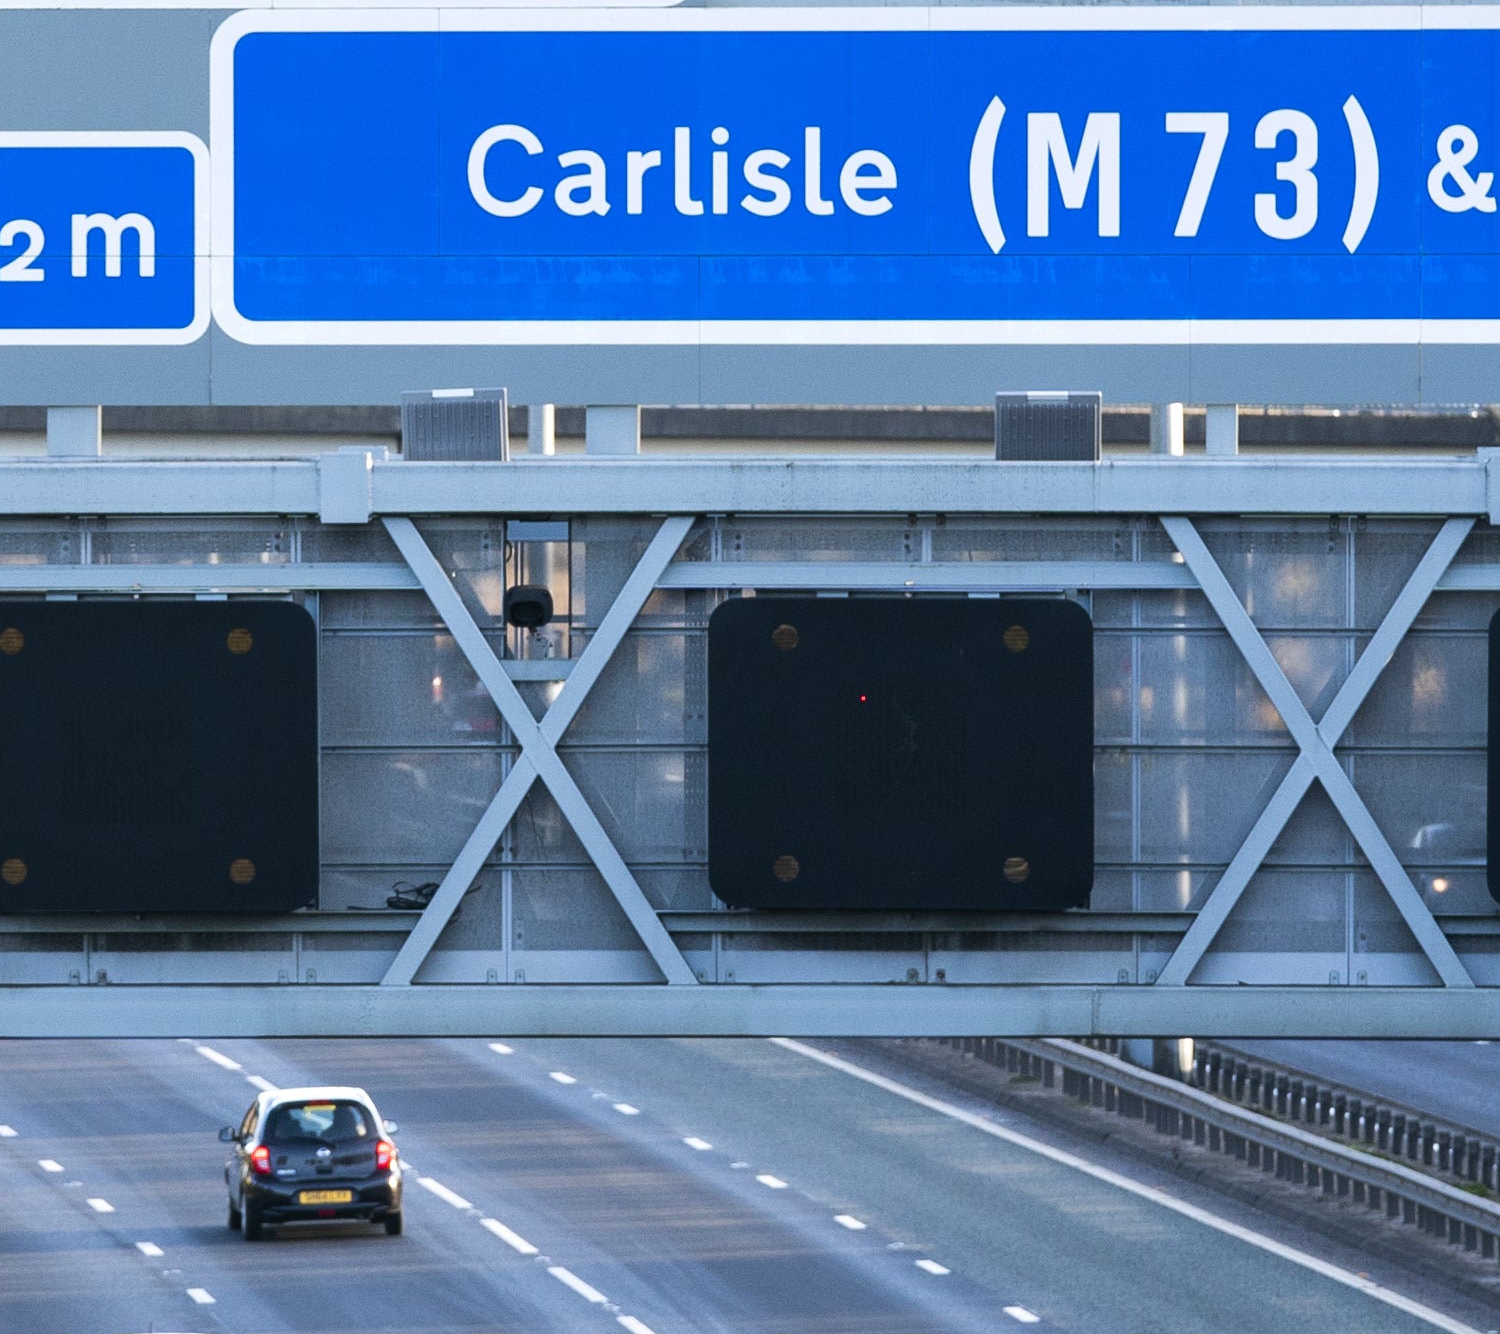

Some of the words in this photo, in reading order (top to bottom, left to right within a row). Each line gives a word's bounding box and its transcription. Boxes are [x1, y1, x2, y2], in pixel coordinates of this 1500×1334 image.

[468, 125, 897, 216] Carlisle
[1428, 125, 1496, 212] &
[72, 213, 154, 276] m
